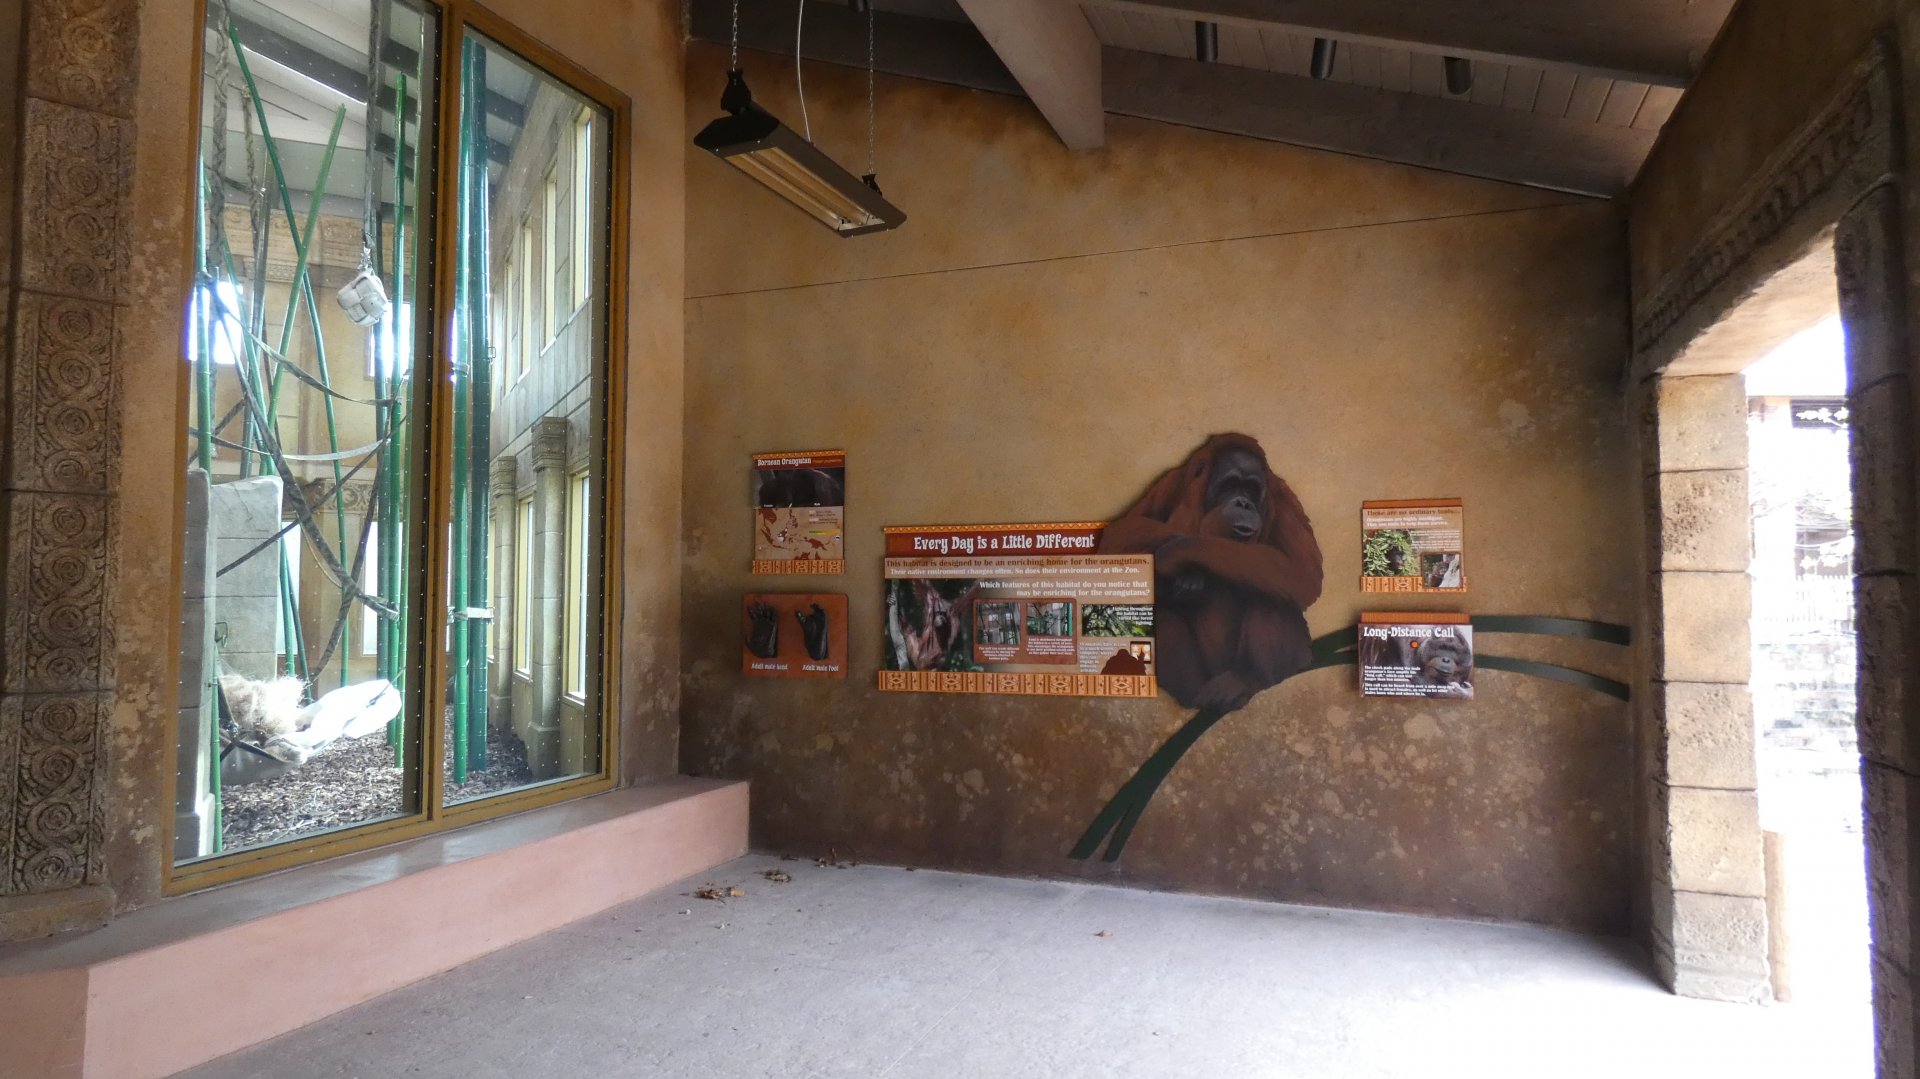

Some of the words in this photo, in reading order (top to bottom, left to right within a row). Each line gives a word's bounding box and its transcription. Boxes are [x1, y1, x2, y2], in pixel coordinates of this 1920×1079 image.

[782, 458, 812, 466] Orangutan
[914, 537, 948, 554] Every
[952, 536, 974, 554] Day
[977, 536, 987, 549] is
[990, 539, 999, 549] a
[1002, 535, 1033, 549] Little
[1036, 534, 1095, 549] Different
[939, 560, 972, 568] designed
[1008, 559, 1044, 567] enriching
[1100, 558, 1150, 566] orangutans.
[1104, 589, 1150, 597] orangutans?
[1363, 627, 1432, 641] Long-Distance
[1434, 627, 1455, 638] Call
